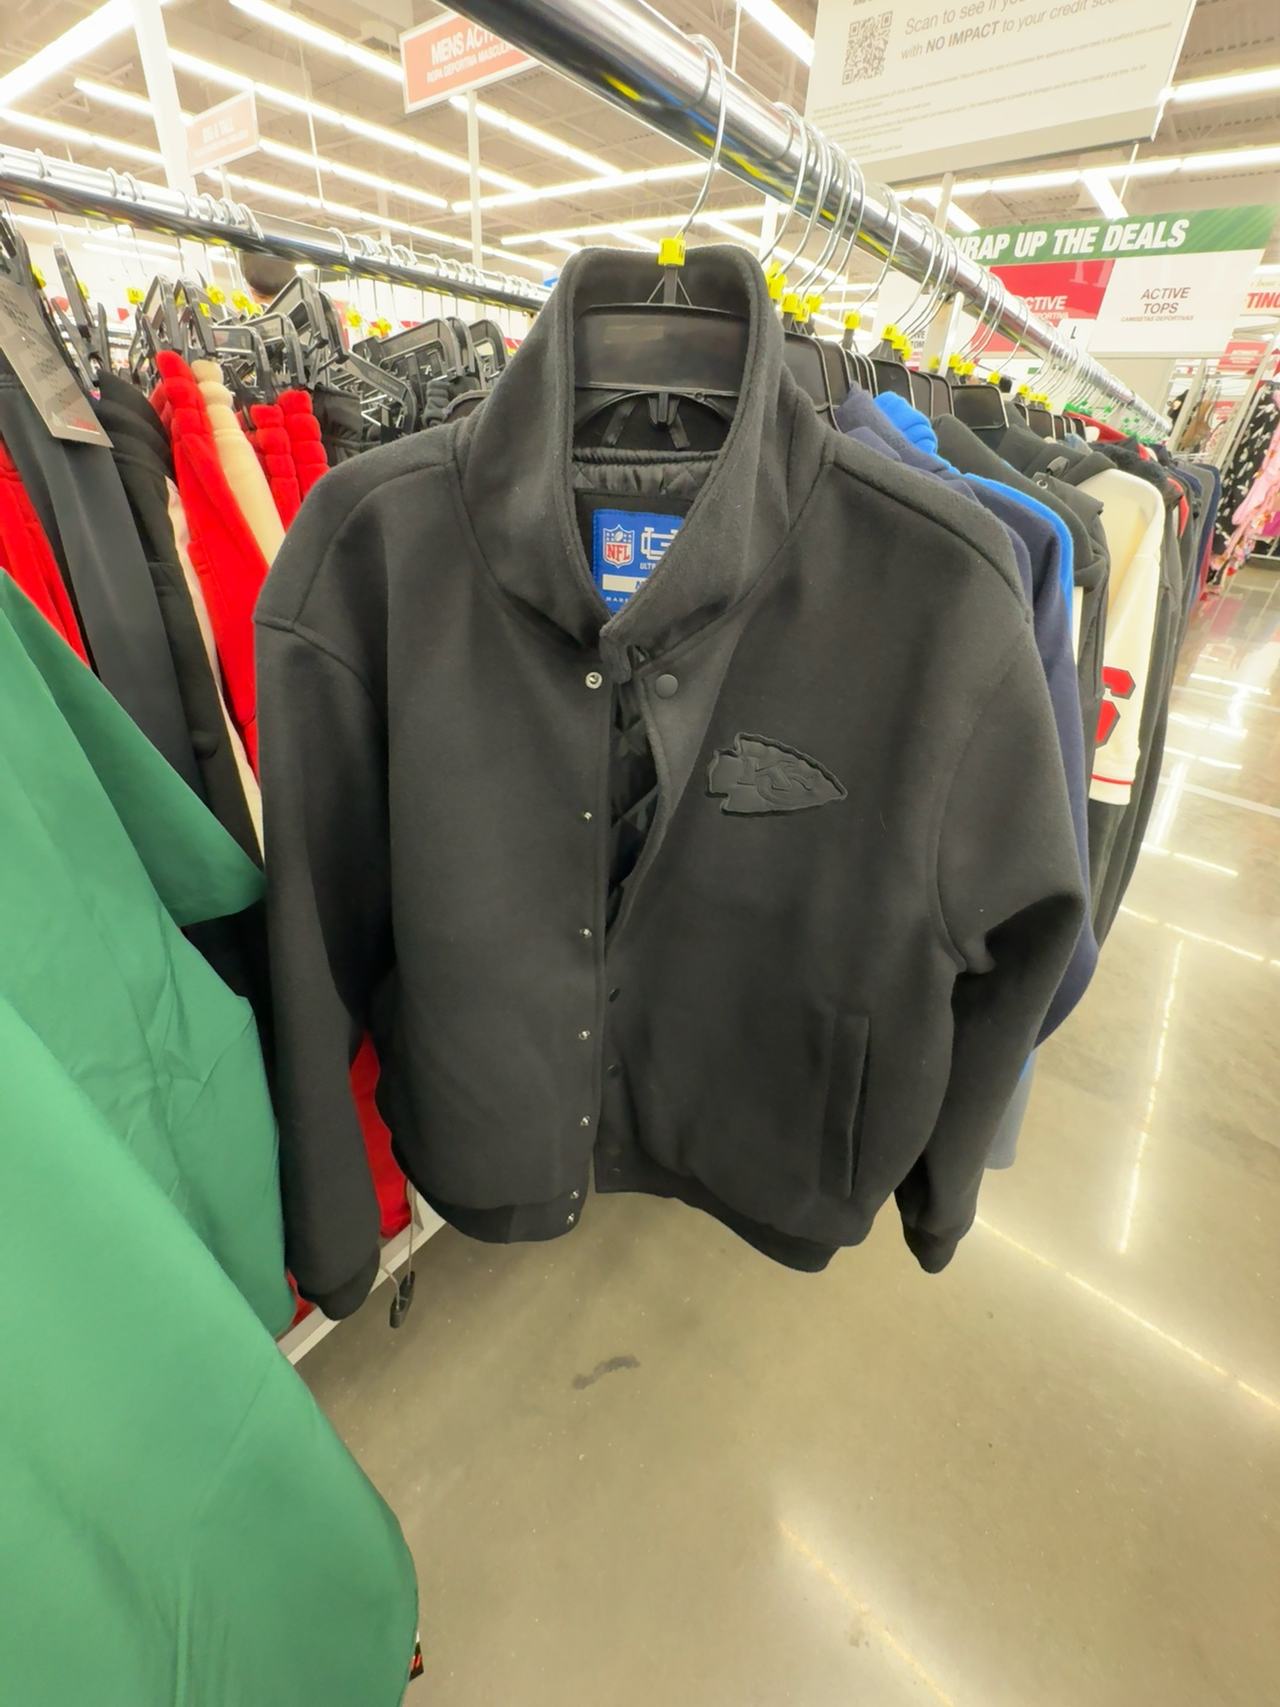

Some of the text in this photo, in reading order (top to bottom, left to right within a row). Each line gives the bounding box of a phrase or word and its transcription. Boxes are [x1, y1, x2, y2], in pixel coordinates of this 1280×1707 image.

[904, 13, 939, 36] Scan
[943, 8, 956, 25] to
[959, 1, 985, 20] see
[900, 43, 923, 61] with
[925, 35, 945, 54] NO
[947, 20, 1001, 48] IMPACT
[1002, 18, 1015, 33] to
[1016, 8, 1048, 33] your
[1049, 0, 1088, 20] credit
[431, 31, 465, 66] MENS
[1014, 231, 1048, 258] UP
[1052, 226, 1100, 256] THE
[1102, 218, 1191, 254] DEALS
[1140, 287, 1191, 300] ACTIVE
[1022, 295, 1068, 311] CTIVE
[1143, 302, 1179, 315] TOPS
[1070, 325, 1077, 340] L
[606, 544, 630, 562] NFL
